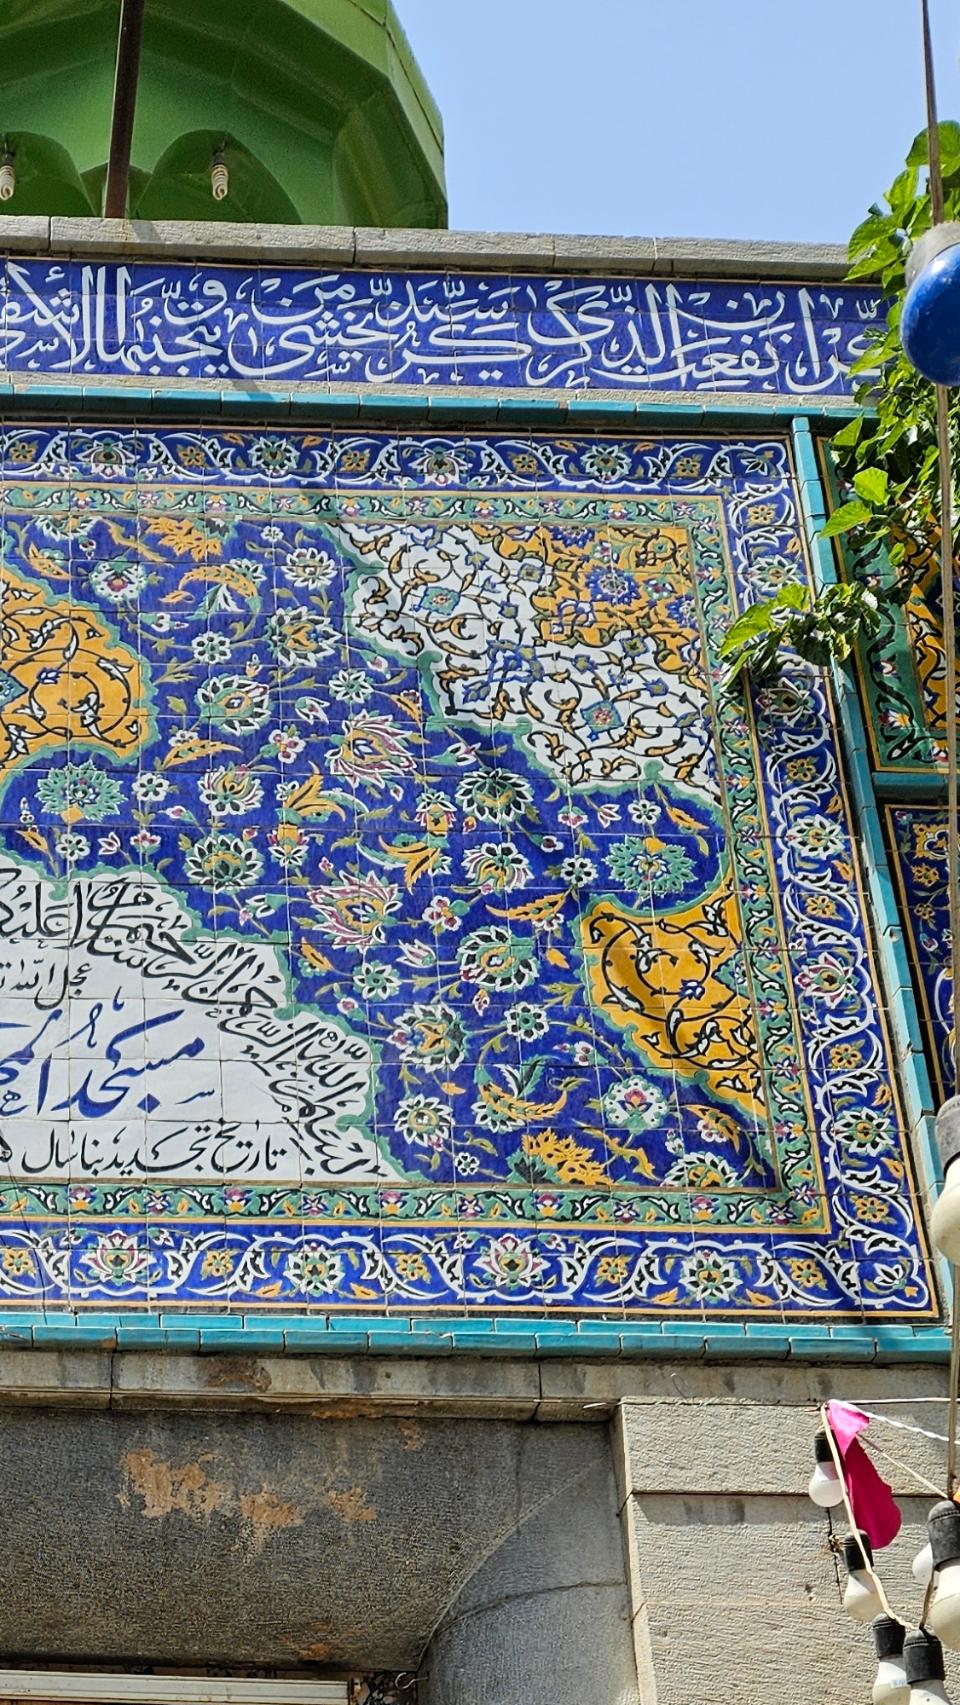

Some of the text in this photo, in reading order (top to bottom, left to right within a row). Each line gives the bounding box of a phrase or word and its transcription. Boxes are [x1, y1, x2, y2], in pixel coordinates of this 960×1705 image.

[10, 957, 55, 991] الله
[34, 962, 93, 1010] عجل
[50, 1002, 206, 1118] مسجد
